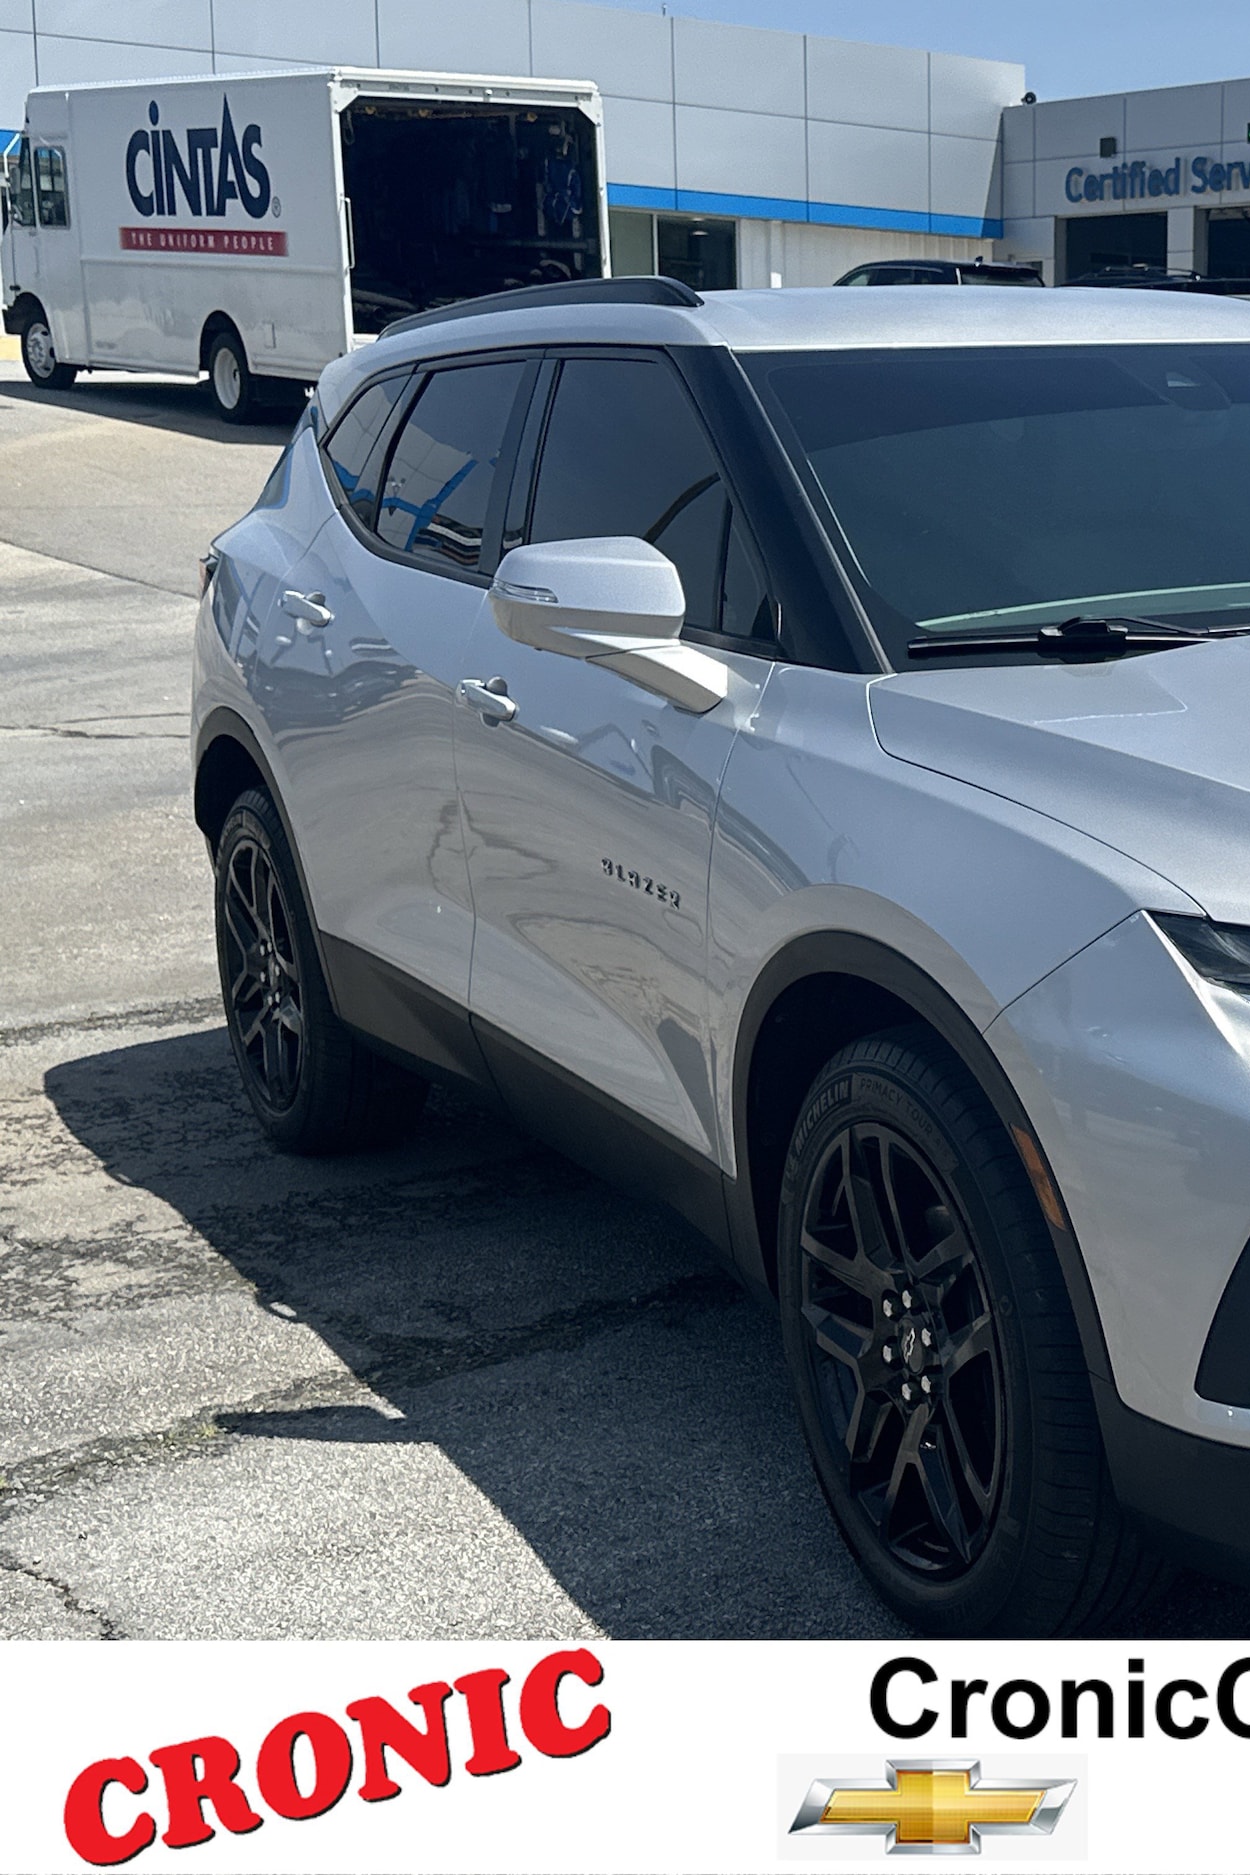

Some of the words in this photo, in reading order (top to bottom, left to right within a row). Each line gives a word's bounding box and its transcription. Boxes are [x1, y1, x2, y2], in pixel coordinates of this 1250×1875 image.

[1065, 157, 1181, 203] Certified
[131, 232, 153, 246] THE
[160, 233, 215, 249] UNIFORM
[224, 235, 274, 251] PEOPLE
[601, 857, 681, 910] BLAZER
[794, 1079, 849, 1157] MICHELIN
[860, 1077, 903, 1106] PRIMACY
[907, 1102, 935, 1137] TOUR
